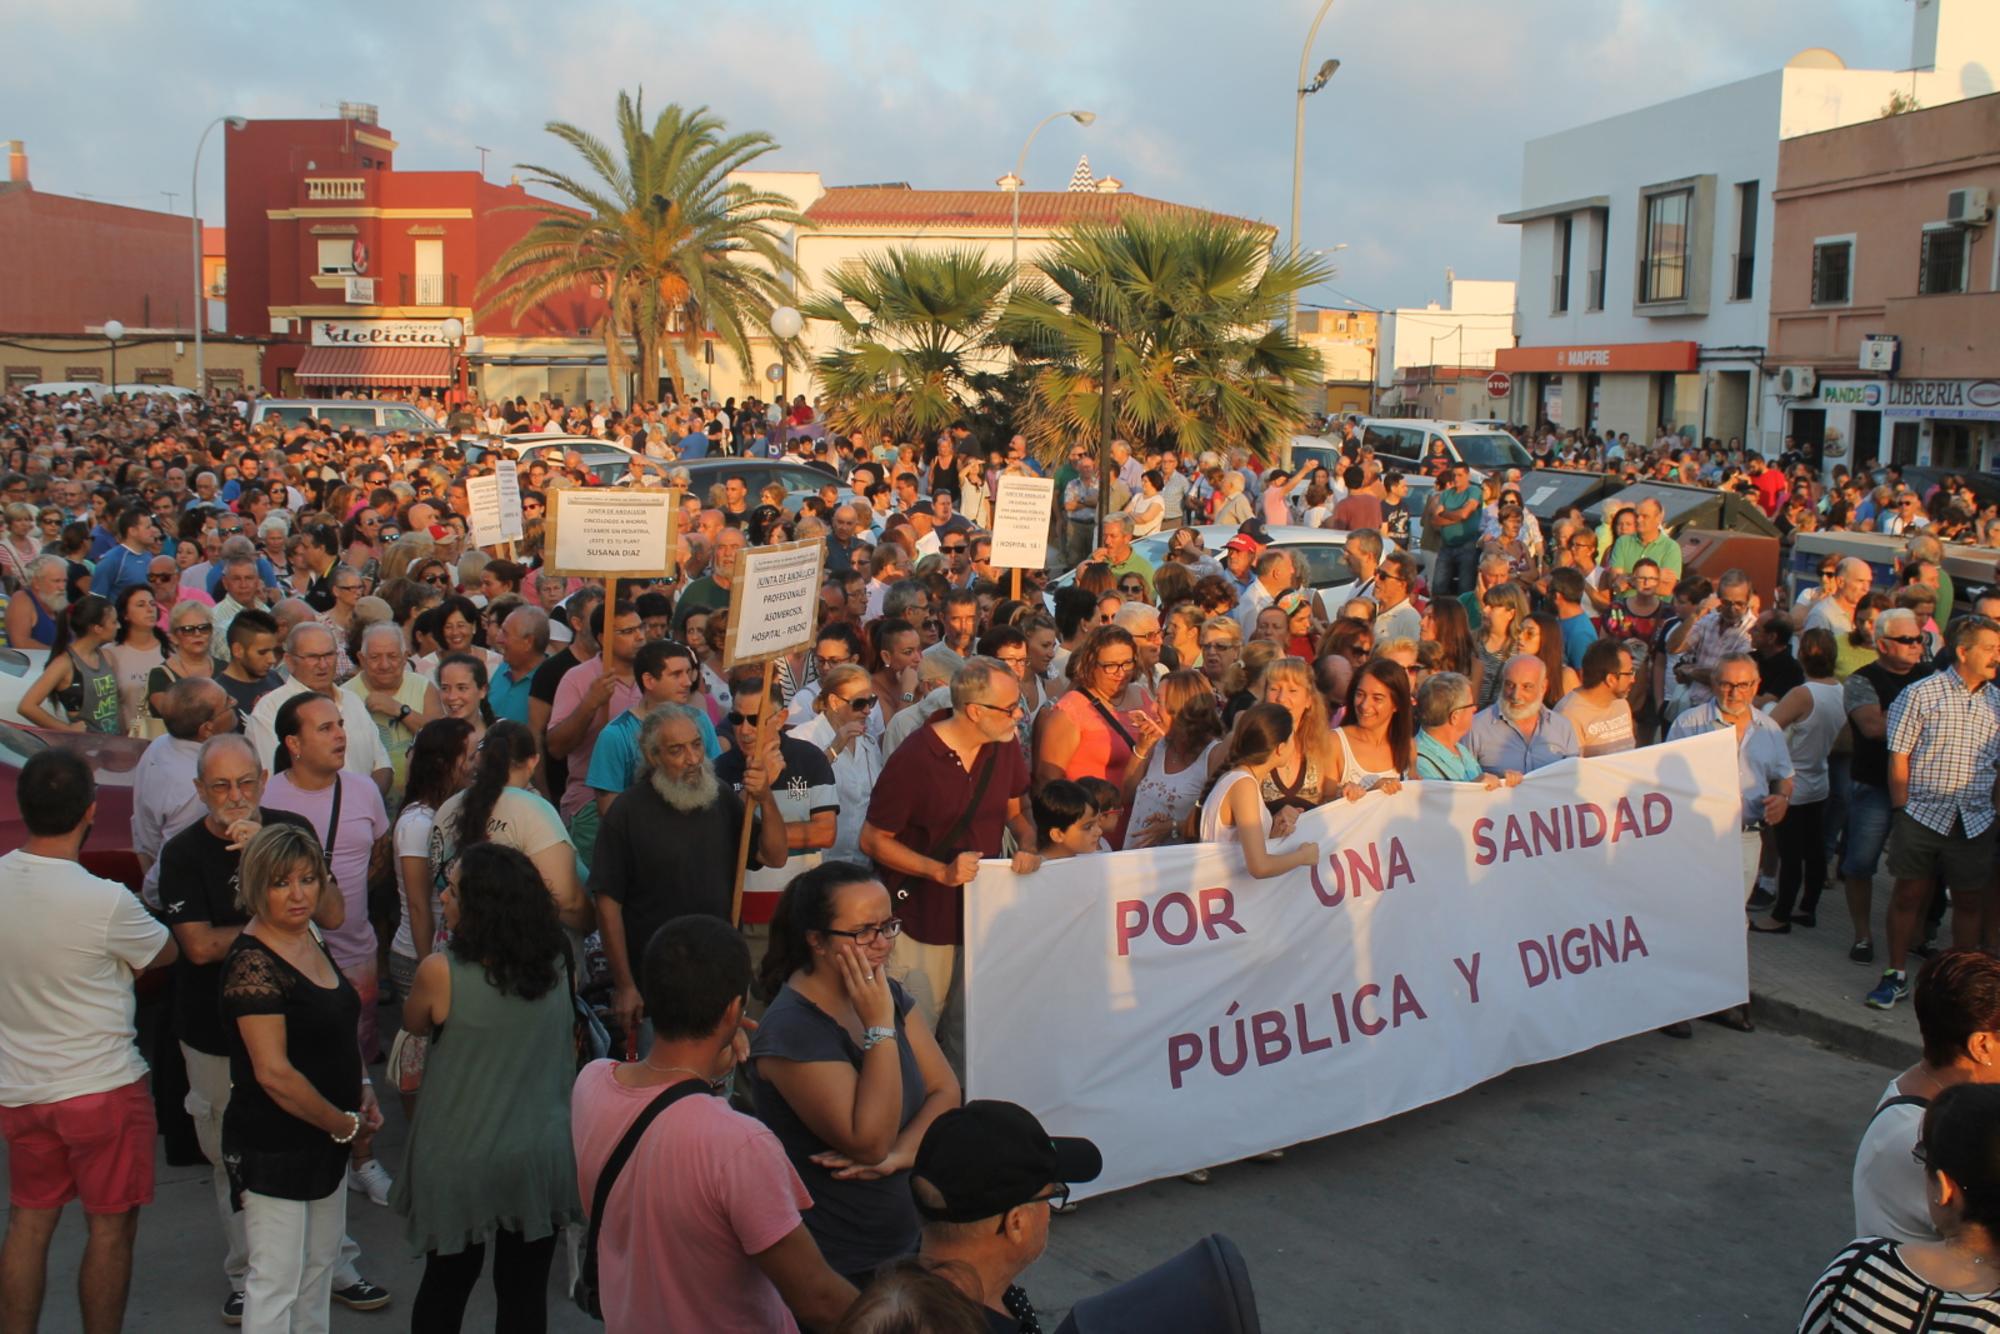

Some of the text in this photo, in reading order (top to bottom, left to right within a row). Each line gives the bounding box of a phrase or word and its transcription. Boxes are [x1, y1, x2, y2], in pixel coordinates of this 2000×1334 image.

[1568, 350, 1610, 366] MAPFRE
[1488, 381, 1510, 389] STOP
[1887, 383, 1964, 406] LIBRERIA
[622, 549, 641, 557] DIAZ
[758, 574, 777, 586] JUNTA
[779, 573, 788, 584] DE
[763, 587, 807, 604] PROFESIONALES
[751, 630, 781, 642] HOSPITAL
[1116, 792, 1673, 956] POR UNA SANIDAD
[1168, 915, 1649, 1090] PÚBLICA Y DIGNA
